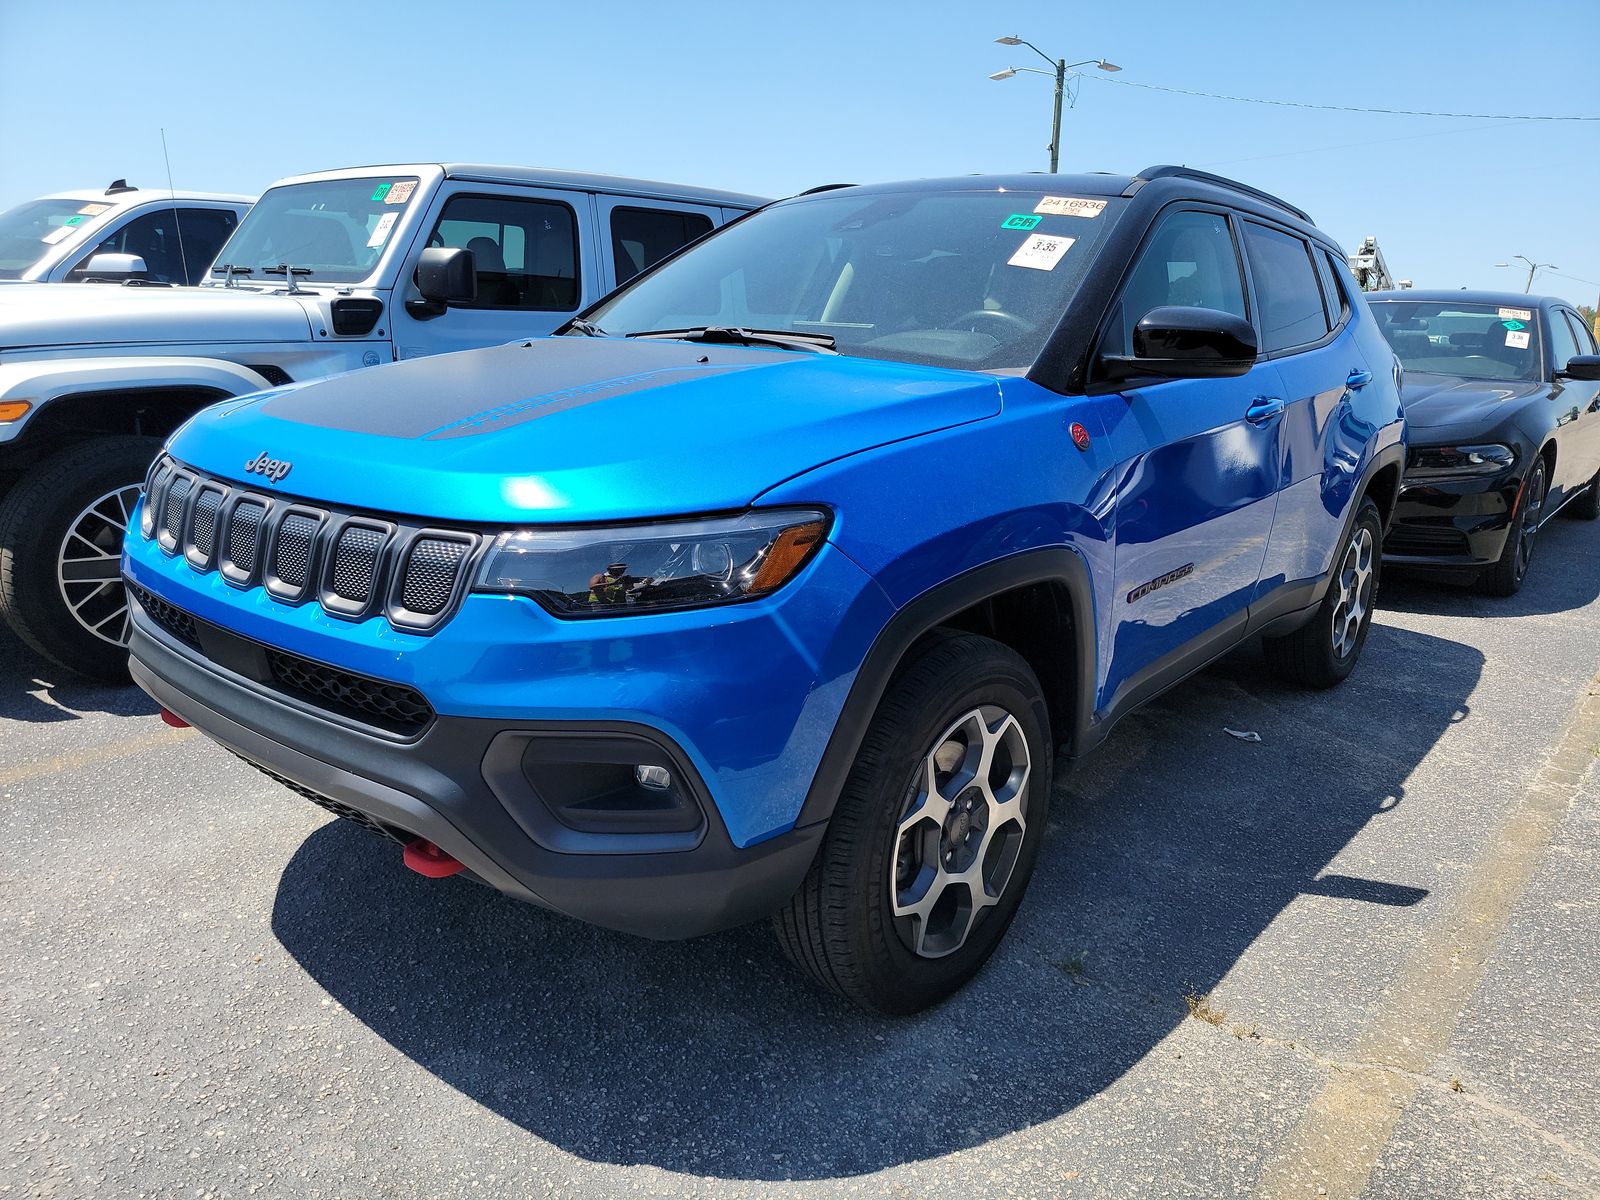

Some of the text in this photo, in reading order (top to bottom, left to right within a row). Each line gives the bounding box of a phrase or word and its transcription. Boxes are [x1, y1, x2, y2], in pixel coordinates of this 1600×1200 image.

[1042, 198, 1105, 210] 2416936
[1008, 216, 1035, 228] CR
[1032, 241, 1058, 252] 3:35
[244, 451, 292, 484] Jeep
[1126, 562, 1195, 604] COMPASS
